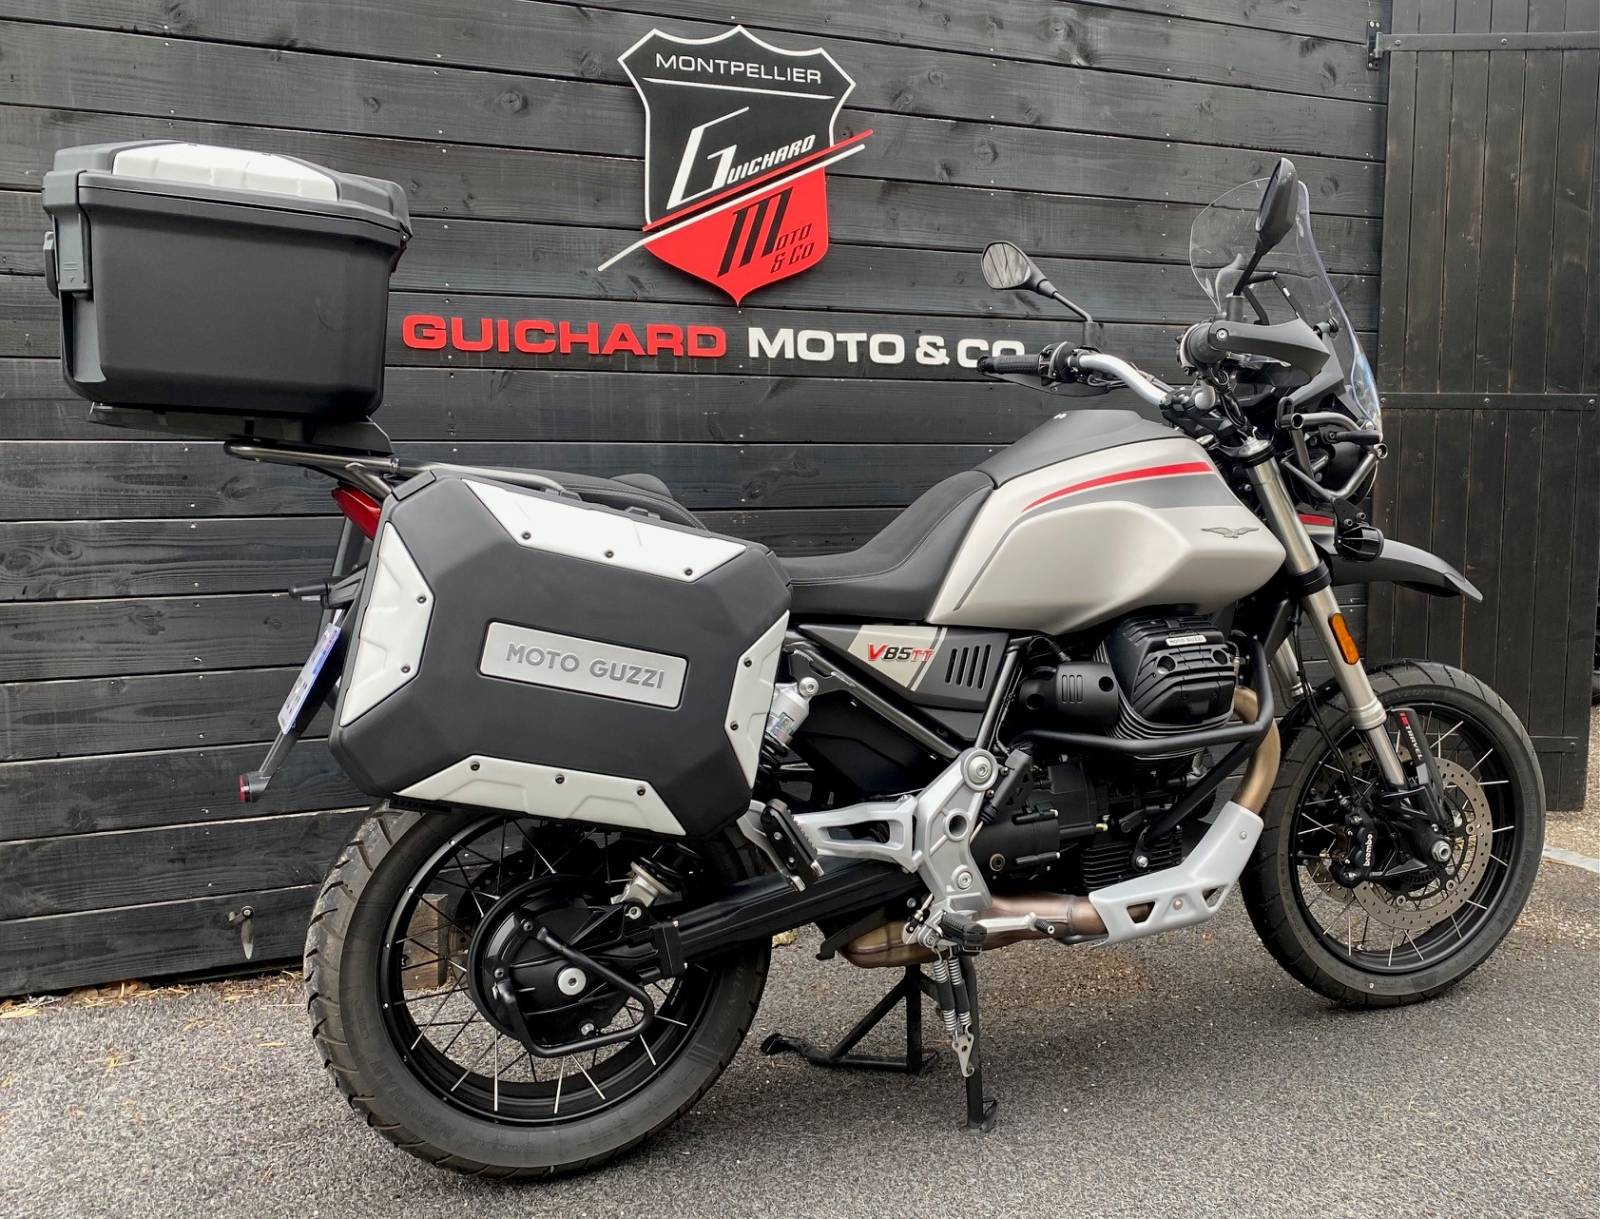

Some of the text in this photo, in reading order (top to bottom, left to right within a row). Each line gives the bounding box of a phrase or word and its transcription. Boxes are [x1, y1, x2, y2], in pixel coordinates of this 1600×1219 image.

[656, 53, 822, 84] MONTPELLIER
[666, 106, 816, 210] GUICHARD
[402, 314, 727, 358] GUICHARD
[748, 327, 905, 364] MOTO
[505, 643, 665, 689] MOTO GUZZI
[1363, 833, 1373, 867] brembo
